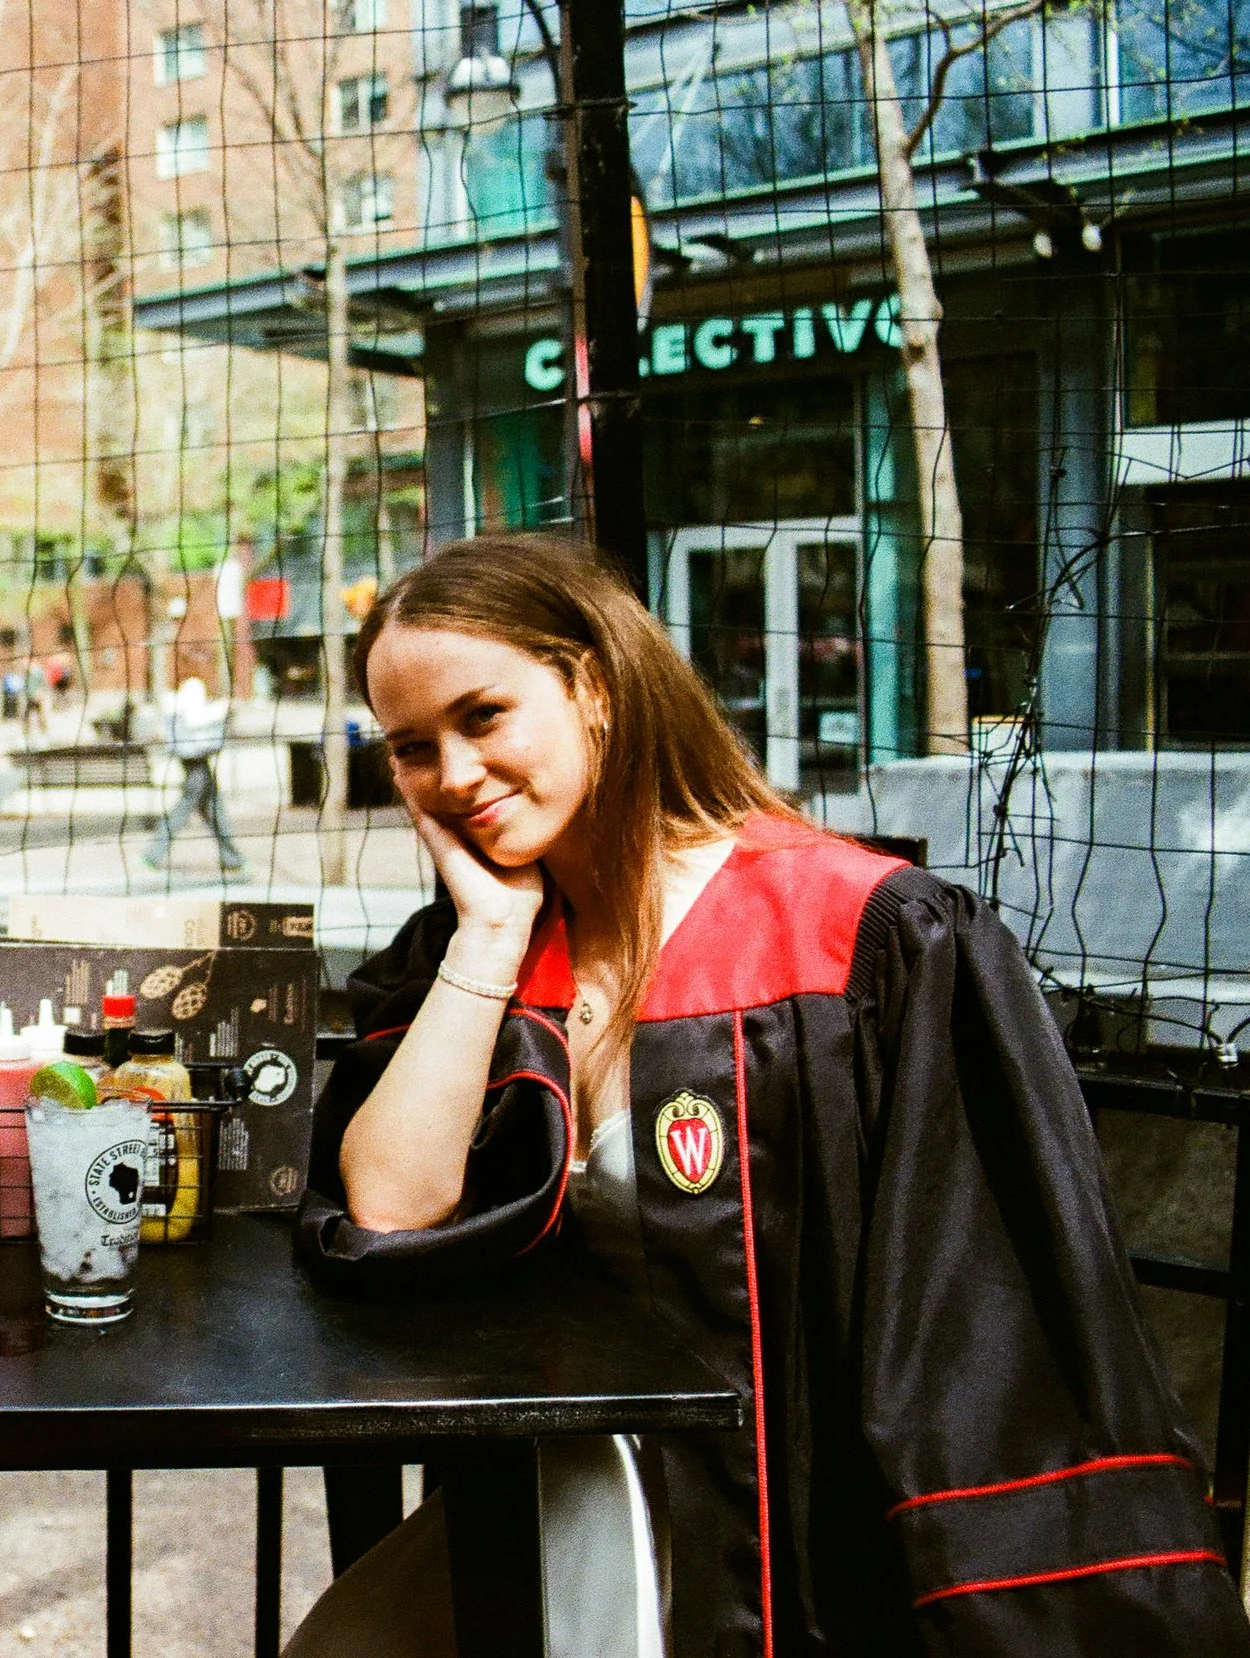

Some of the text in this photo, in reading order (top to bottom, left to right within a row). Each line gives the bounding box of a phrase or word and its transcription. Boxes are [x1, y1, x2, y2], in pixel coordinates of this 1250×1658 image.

[524, 293, 901, 391] CECTIVO
[89, 1158, 111, 1186] STATE
[110, 1143, 141, 1160] STREET
[669, 1126, 708, 1177] W
[93, 1197, 136, 1221] ESTABLISHED
